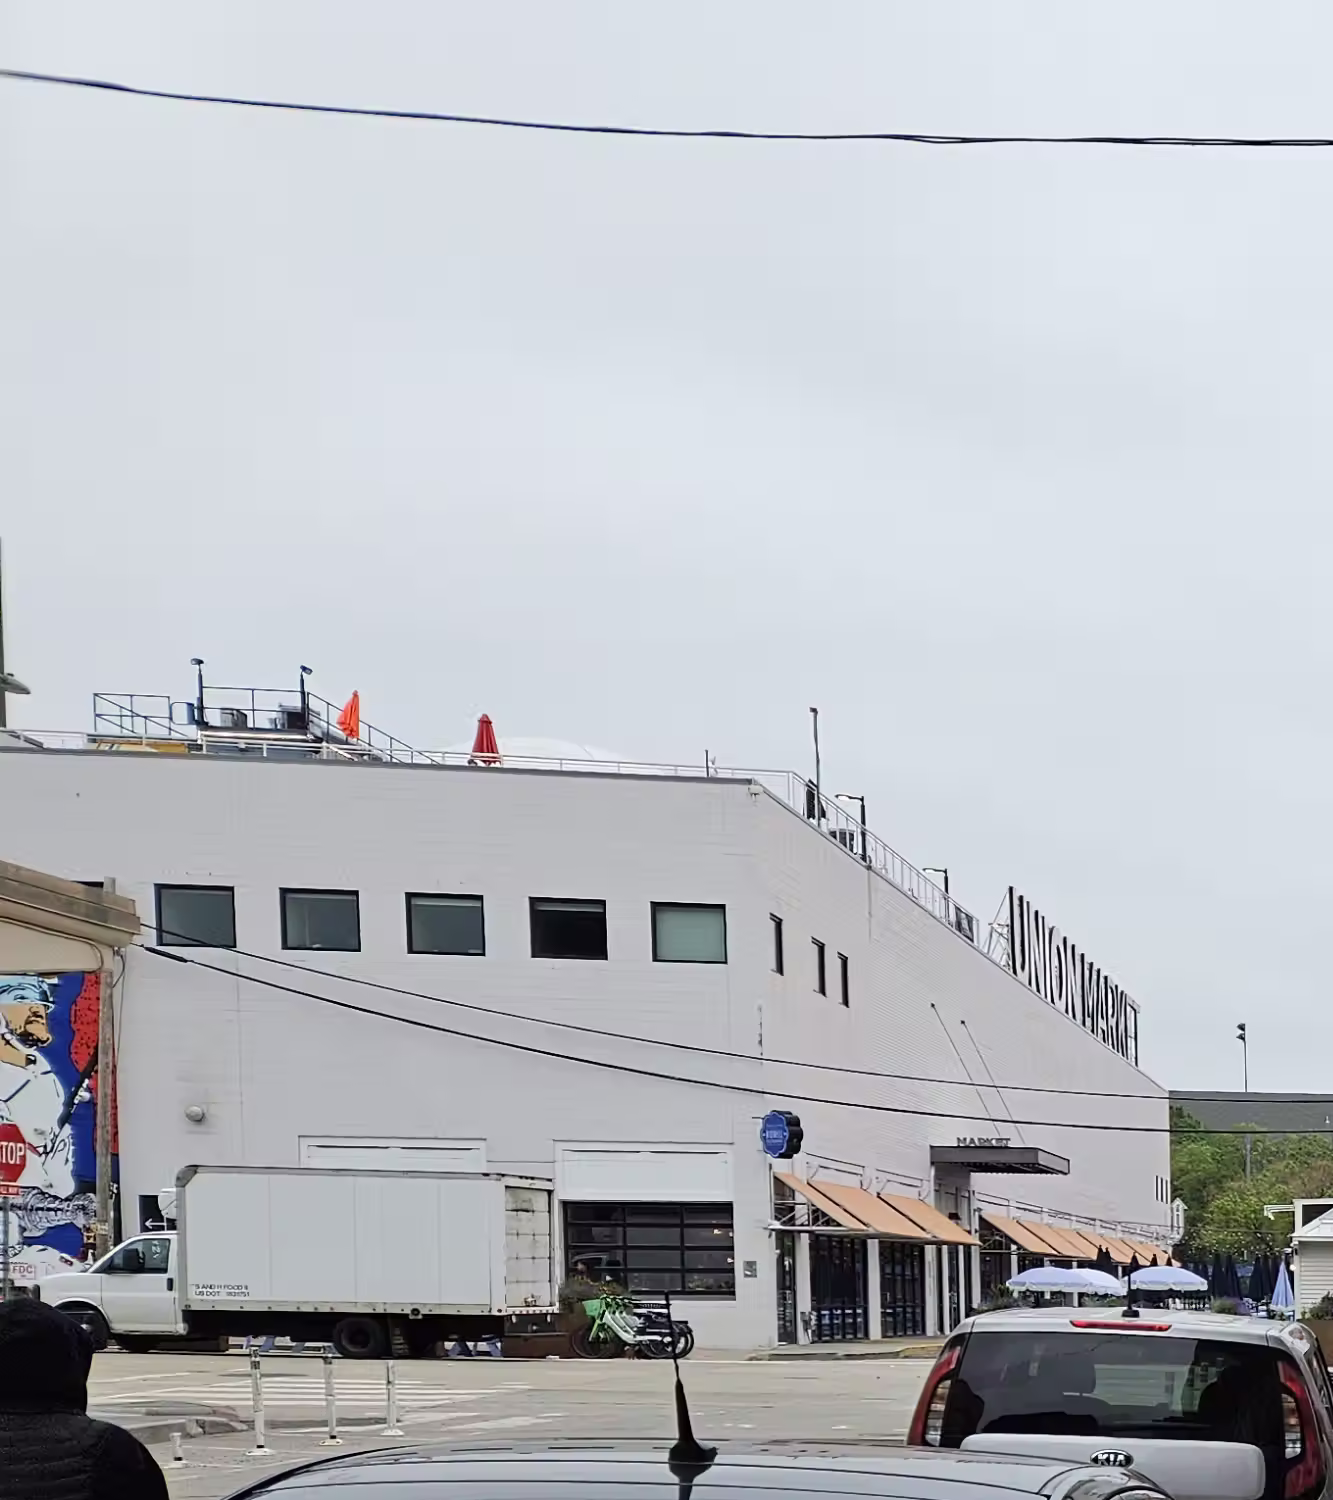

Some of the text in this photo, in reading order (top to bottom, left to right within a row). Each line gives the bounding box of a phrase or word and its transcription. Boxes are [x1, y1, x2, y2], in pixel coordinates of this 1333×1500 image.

[1008, 886, 1076, 1021] UNION
[957, 1136, 1011, 1147] MARKET
[0, 1142, 25, 1164] TOP
[12, 1264, 33, 1275] FDC
